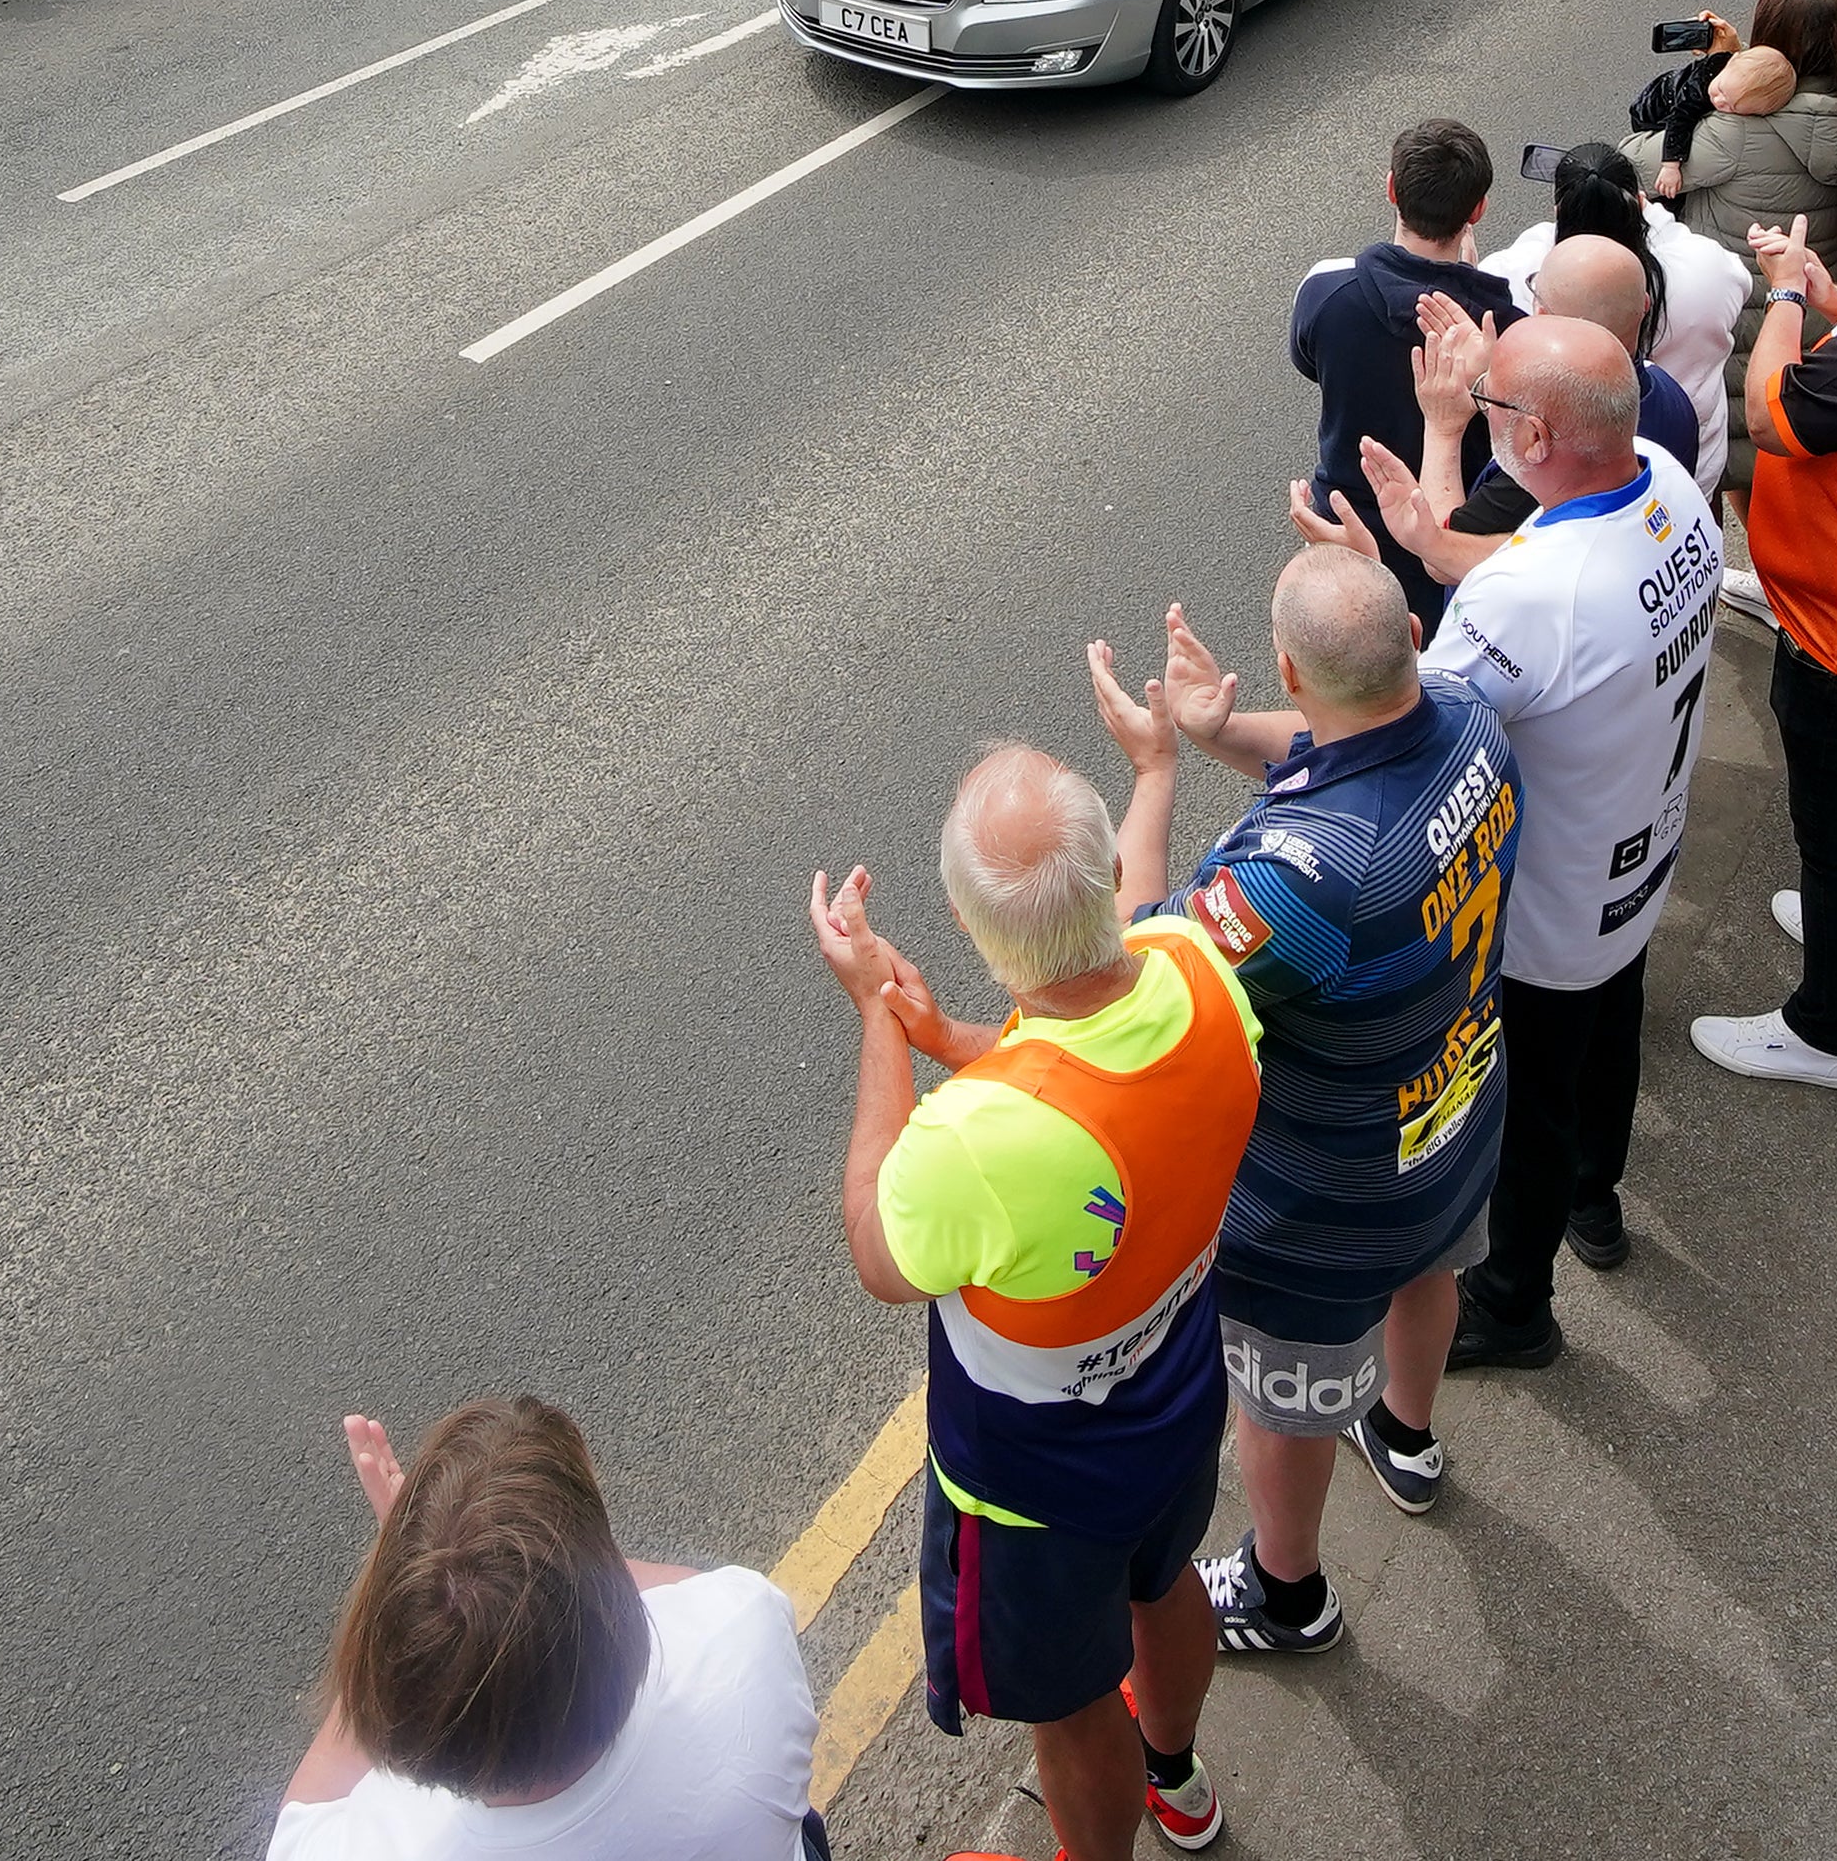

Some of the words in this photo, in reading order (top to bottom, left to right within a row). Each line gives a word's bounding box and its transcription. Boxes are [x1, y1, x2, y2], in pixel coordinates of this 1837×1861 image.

[842, 8, 865, 31] C7
[871, 15, 909, 43] CEA
[1647, 505, 1670, 535] NAPA
[1638, 517, 1710, 614] QUEST
[1650, 550, 1719, 638] SOLUTIONS
[1461, 617, 1523, 679] SOUTHERNS
[1662, 661, 1706, 795] 7
[1426, 747, 1496, 856] QUEST
[1421, 847, 1472, 943] ONE
[1474, 782, 1516, 873] ROB
[1438, 815, 1478, 874] SOLUTIONS
[1220, 919, 1246, 953] Cider
[1451, 862, 1501, 999] 7
[1425, 1135, 1442, 1156] BIG
